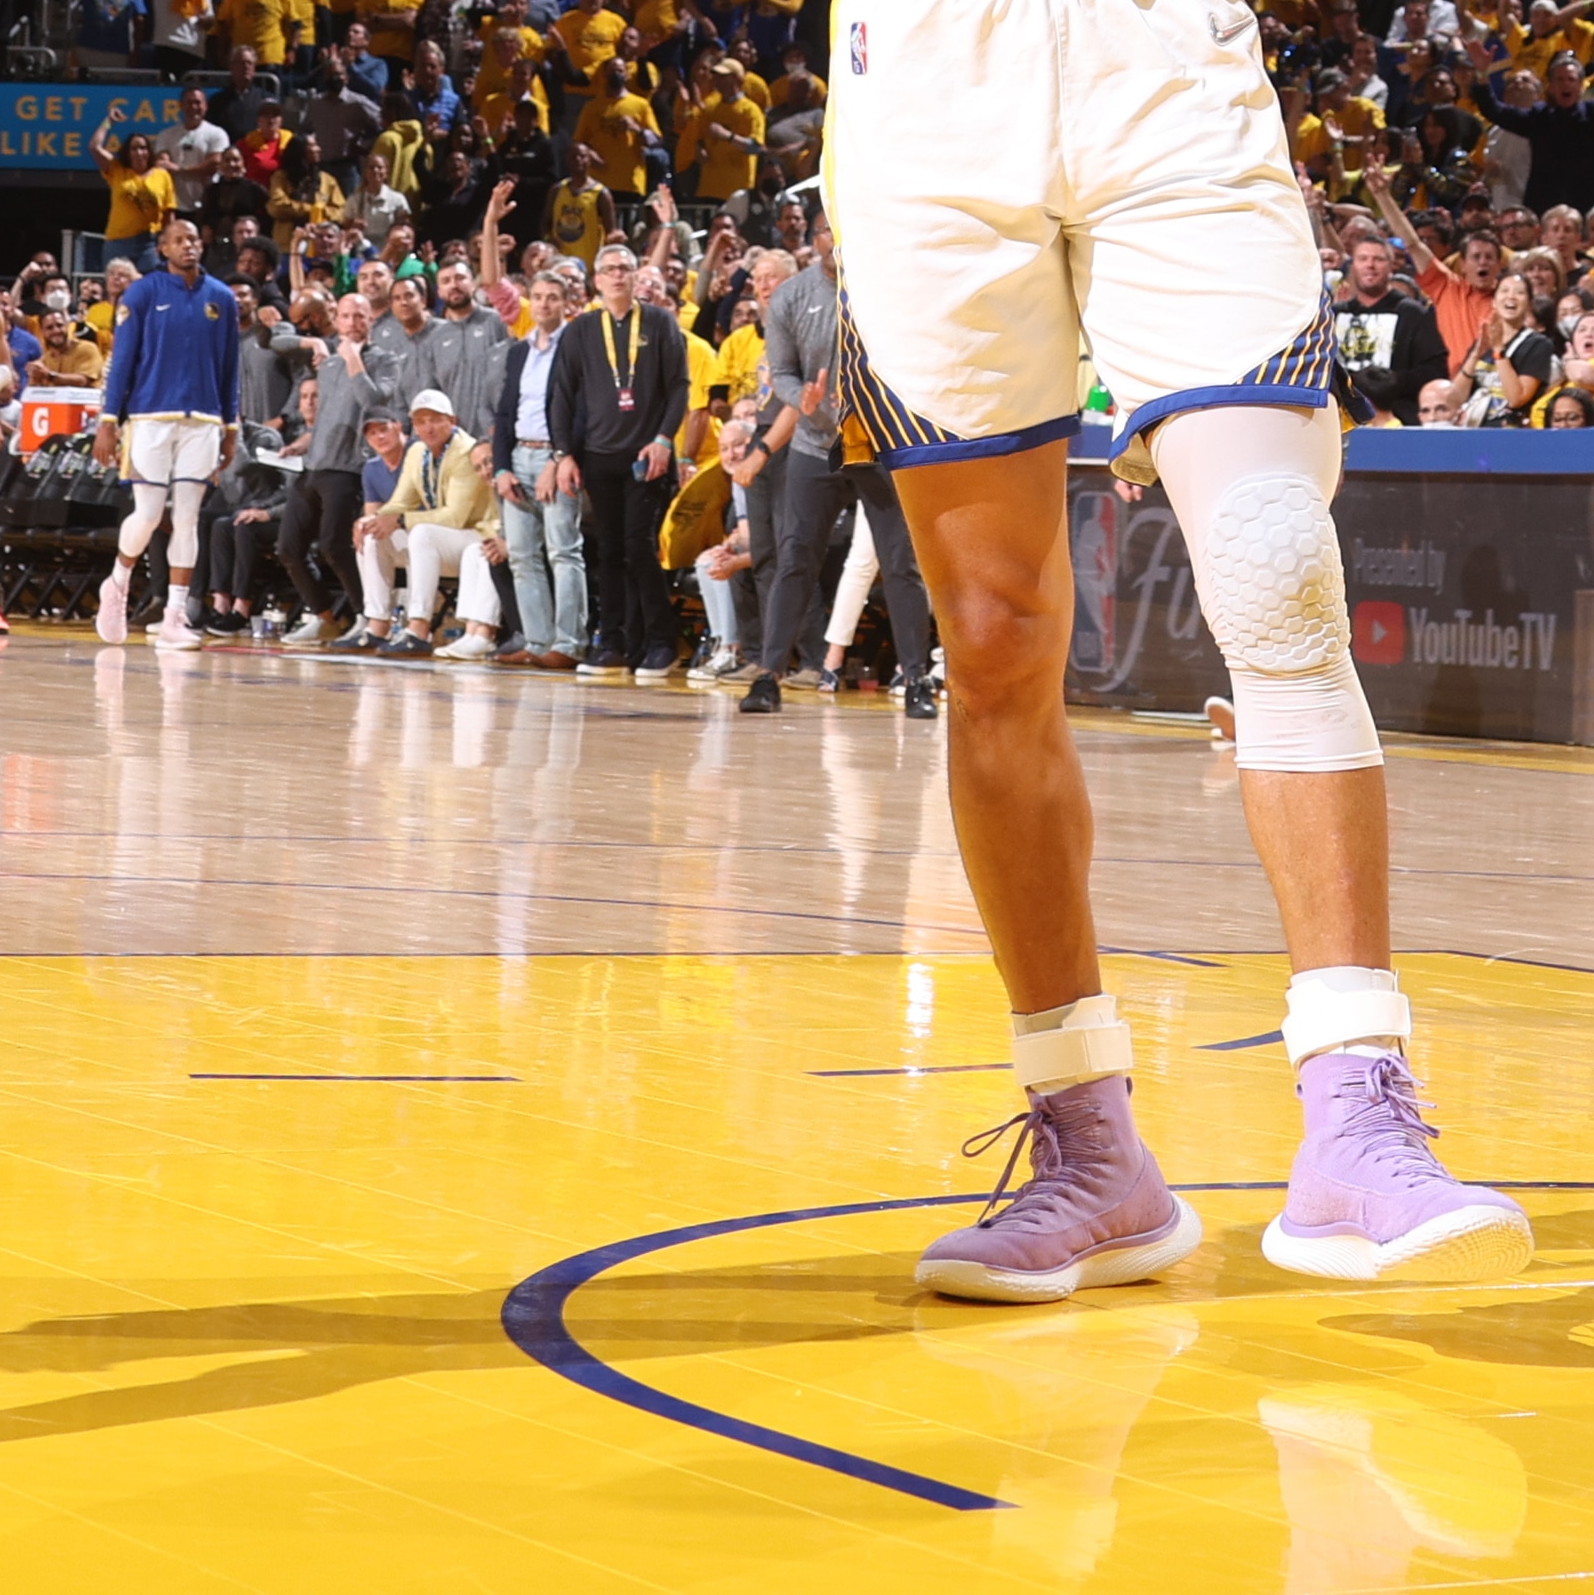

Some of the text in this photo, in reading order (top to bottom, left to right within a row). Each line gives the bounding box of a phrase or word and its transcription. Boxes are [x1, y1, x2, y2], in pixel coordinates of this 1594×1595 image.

[15, 95, 182, 123] GET CAR
[0, 131, 82, 156] LIKE
[31, 406, 50, 437] G
